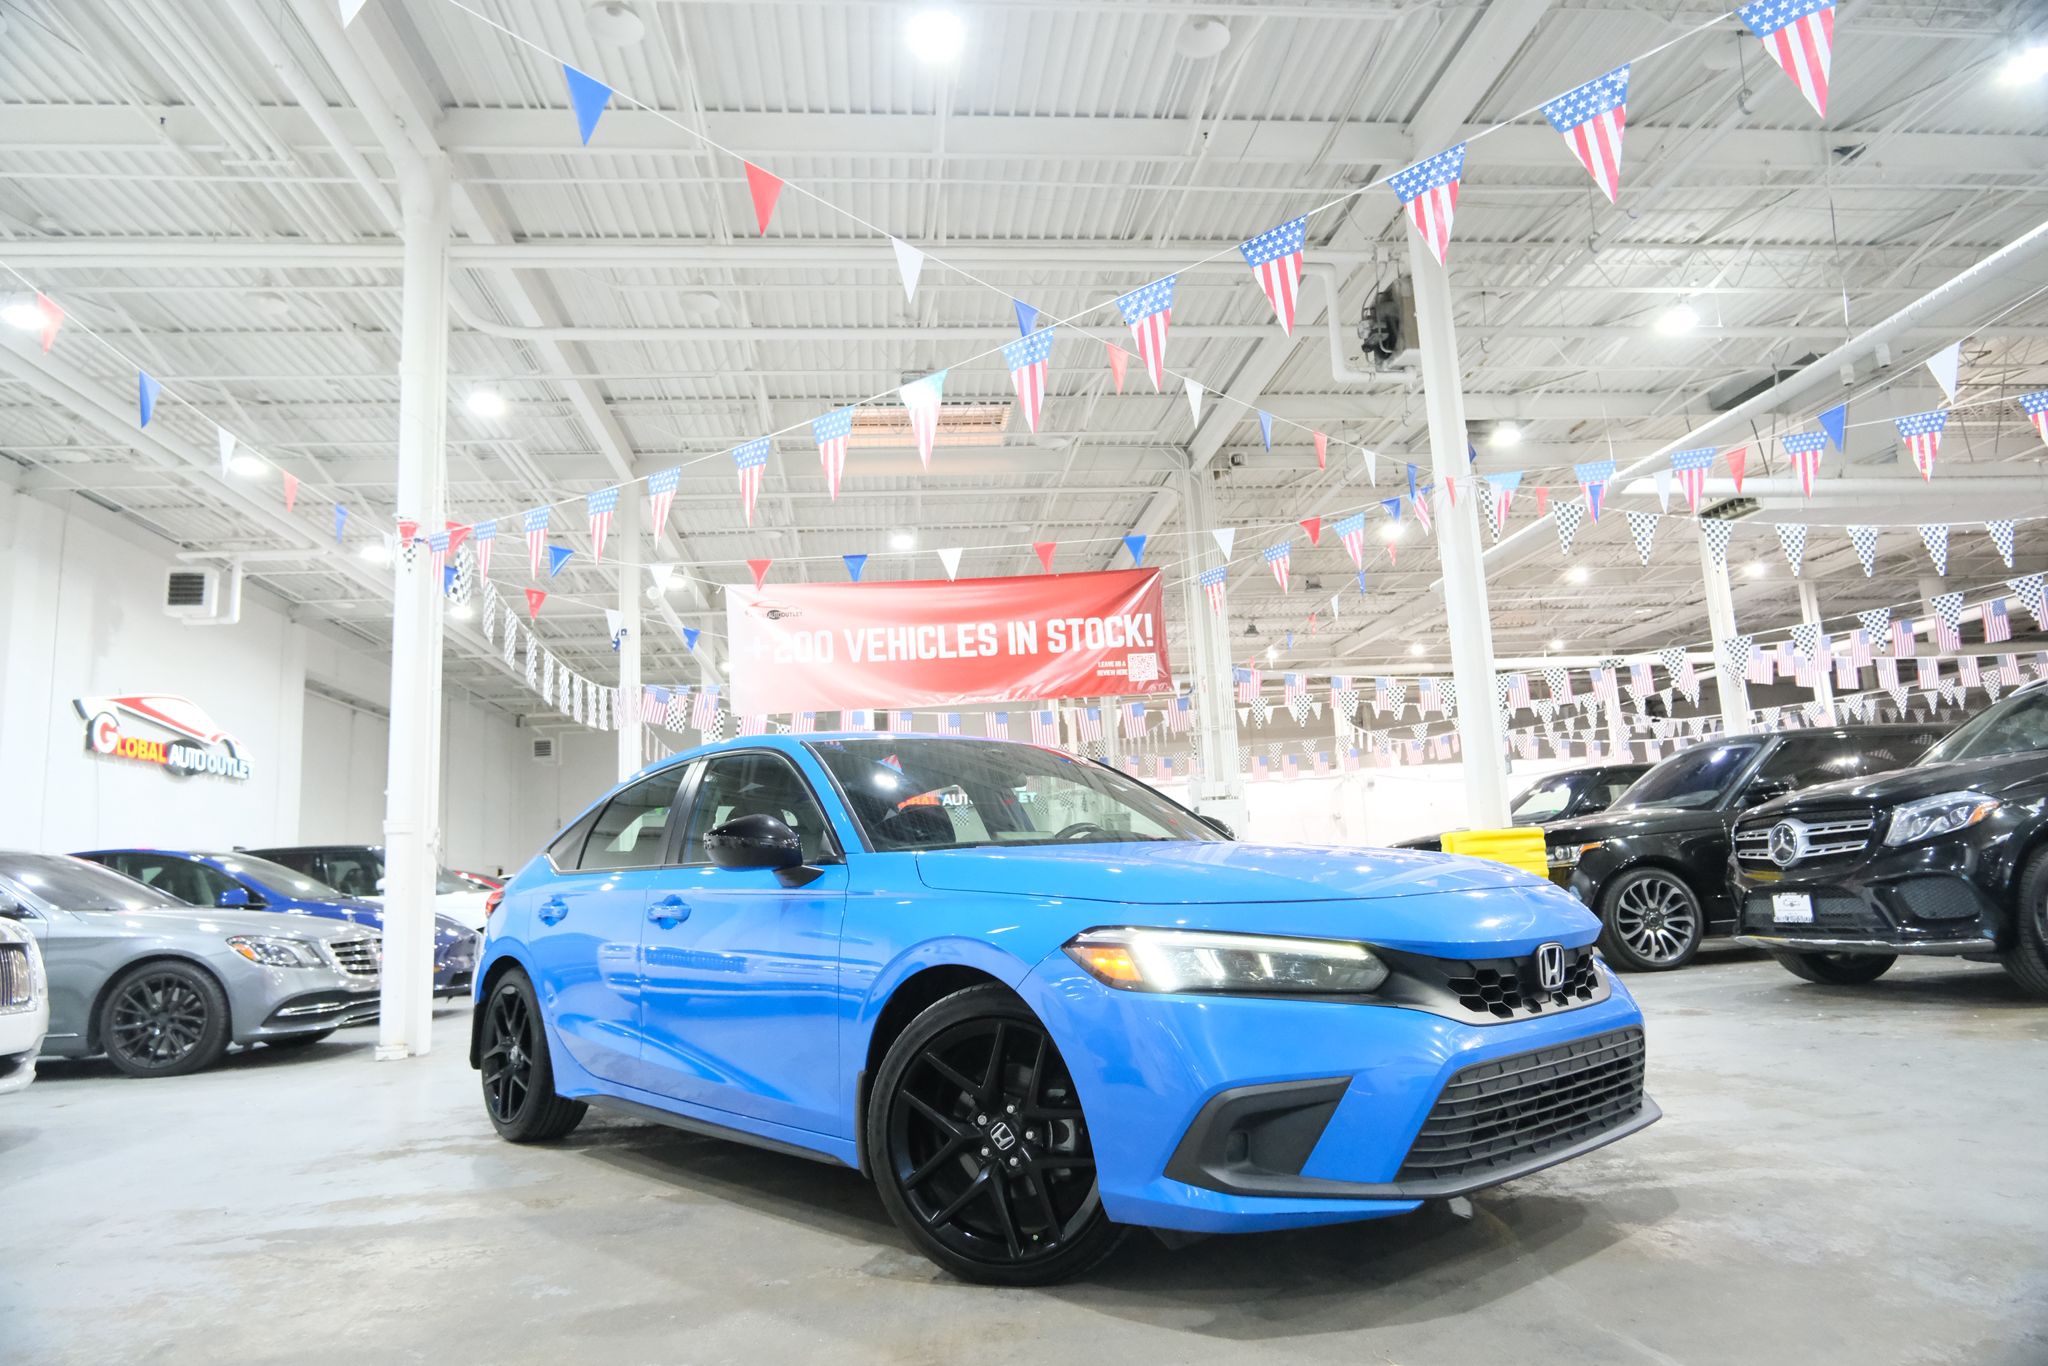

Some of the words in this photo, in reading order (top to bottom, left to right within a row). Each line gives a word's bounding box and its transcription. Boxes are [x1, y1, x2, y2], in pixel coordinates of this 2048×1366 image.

[745, 630, 834, 664] +200
[842, 623, 998, 663] VEHICLES
[1007, 620, 1038, 656] IN
[1047, 613, 1154, 654] STOCK!
[92, 711, 168, 764] GLOBAL
[168, 743, 206, 771] AUTO
[206, 754, 253, 780] OUTLET
